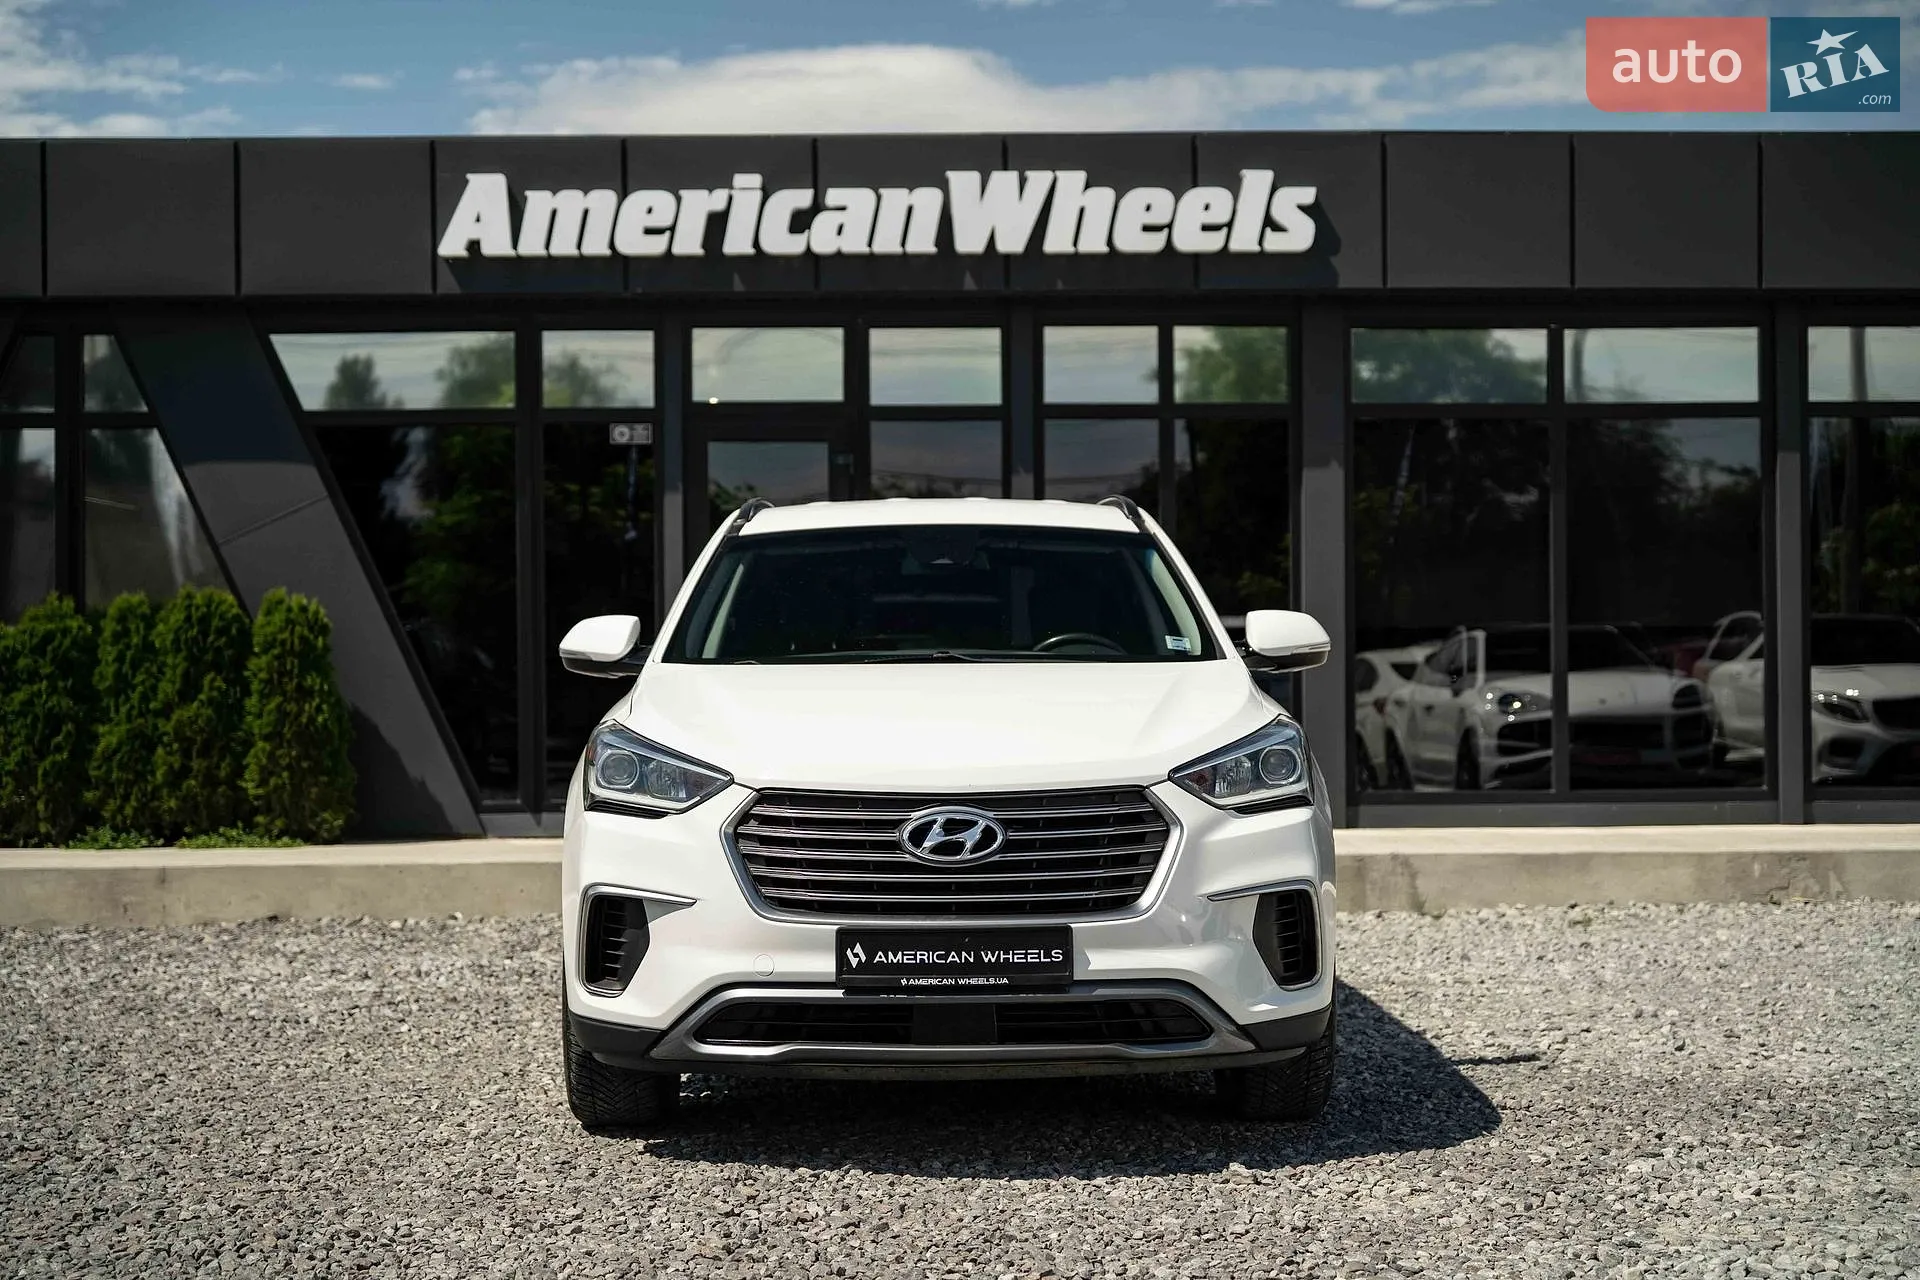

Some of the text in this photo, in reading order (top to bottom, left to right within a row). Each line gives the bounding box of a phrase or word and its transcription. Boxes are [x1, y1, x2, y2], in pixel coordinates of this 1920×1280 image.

[438, 169, 1317, 257] AmericanWheels
[873, 949, 1064, 964] AMERICAN WHEELS
[908, 976, 1009, 985] AMERICAN WHEELS.UA
